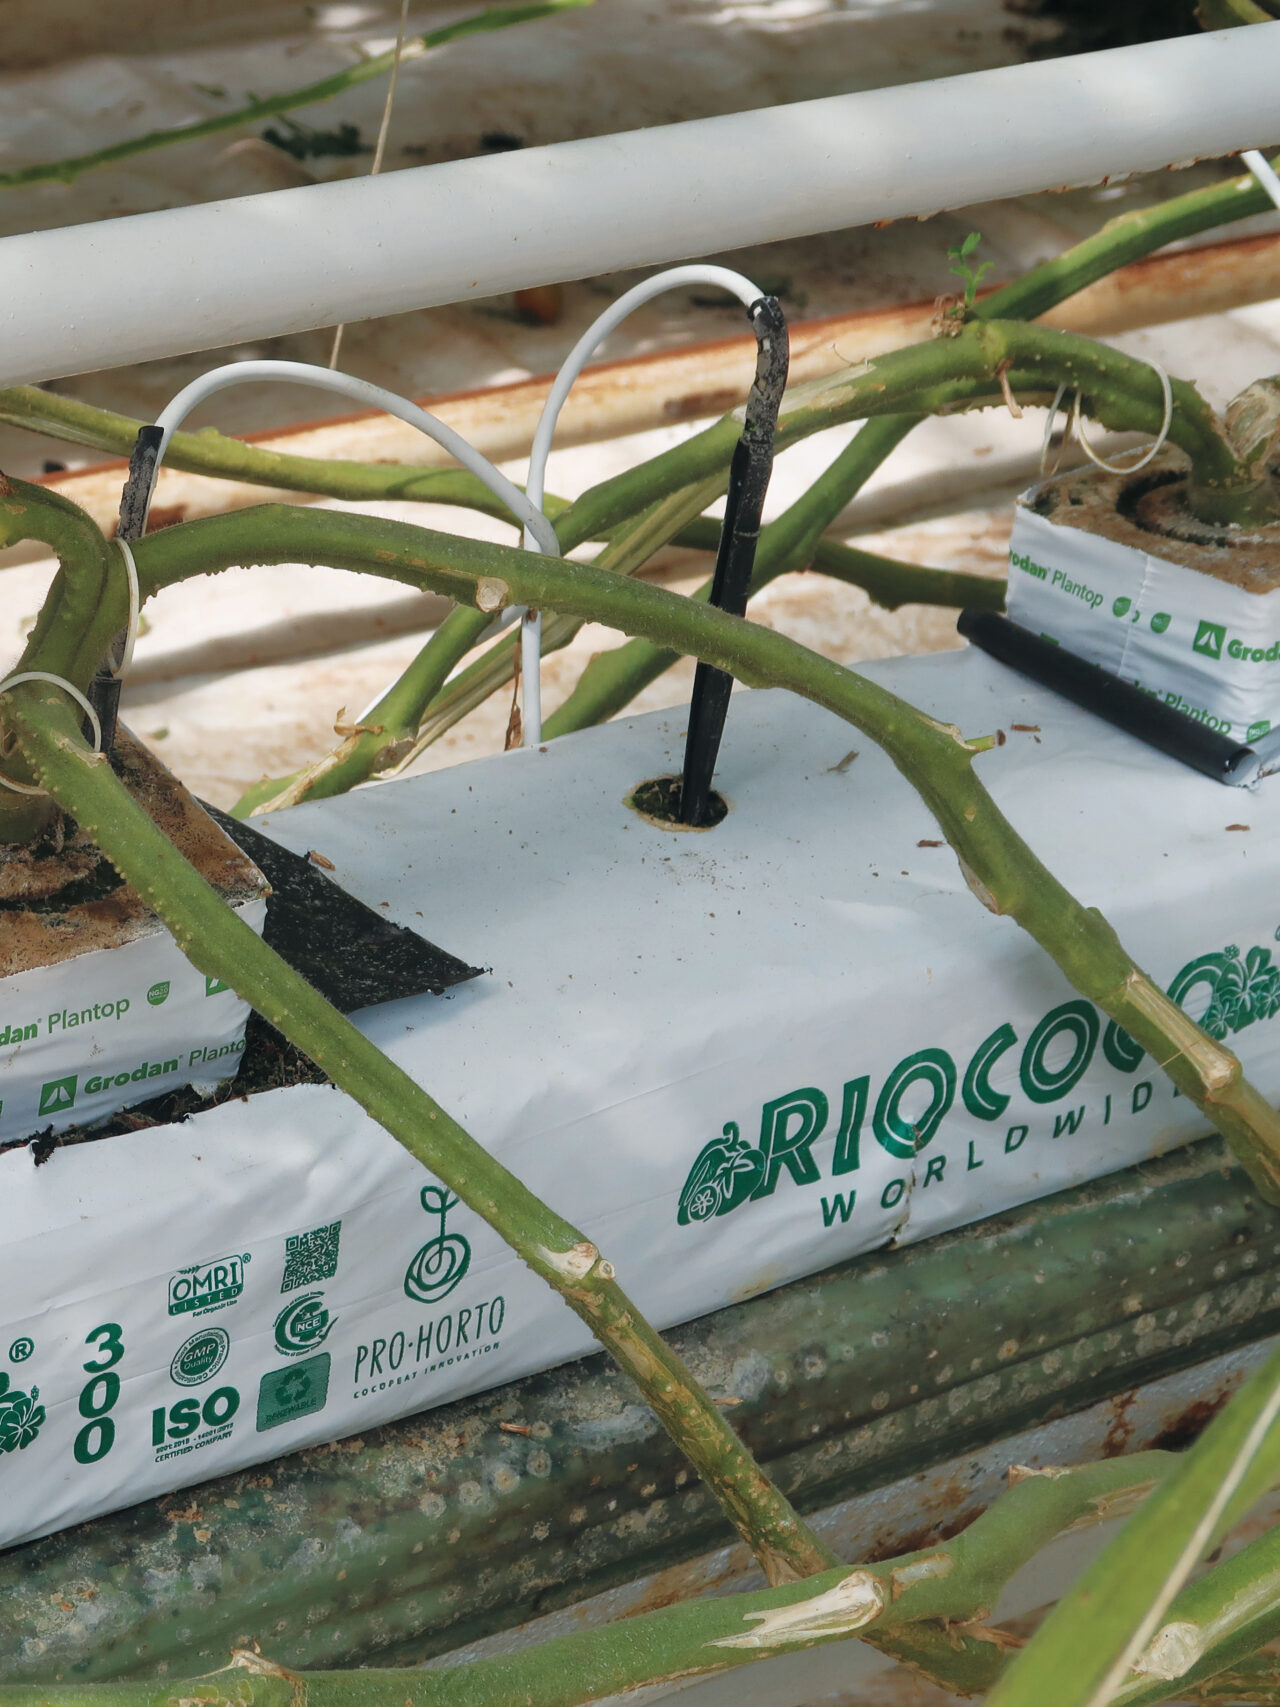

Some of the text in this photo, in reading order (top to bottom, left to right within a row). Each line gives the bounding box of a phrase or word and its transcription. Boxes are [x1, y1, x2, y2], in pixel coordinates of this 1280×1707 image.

[1009, 551, 1048, 580] rodan
[1052, 569, 1104, 609] Plantop
[1227, 639, 1280, 662] Grod
[47, 998, 131, 1034] Plantop
[83, 1039, 247, 1095] Grodan Planto
[821, 1079, 1190, 1228] WORLDWID
[172, 1261, 238, 1301] OMRI
[171, 1286, 239, 1314] LISTED
[297, 1317, 320, 1332] NCE
[183, 1343, 216, 1362] GMP
[183, 1356, 214, 1370] Quality
[353, 1341, 501, 1399] COCOPEAT INNOVATION
[152, 1386, 241, 1447] ISO
[154, 1430, 233, 1463] CERTIFIED COMPANY
